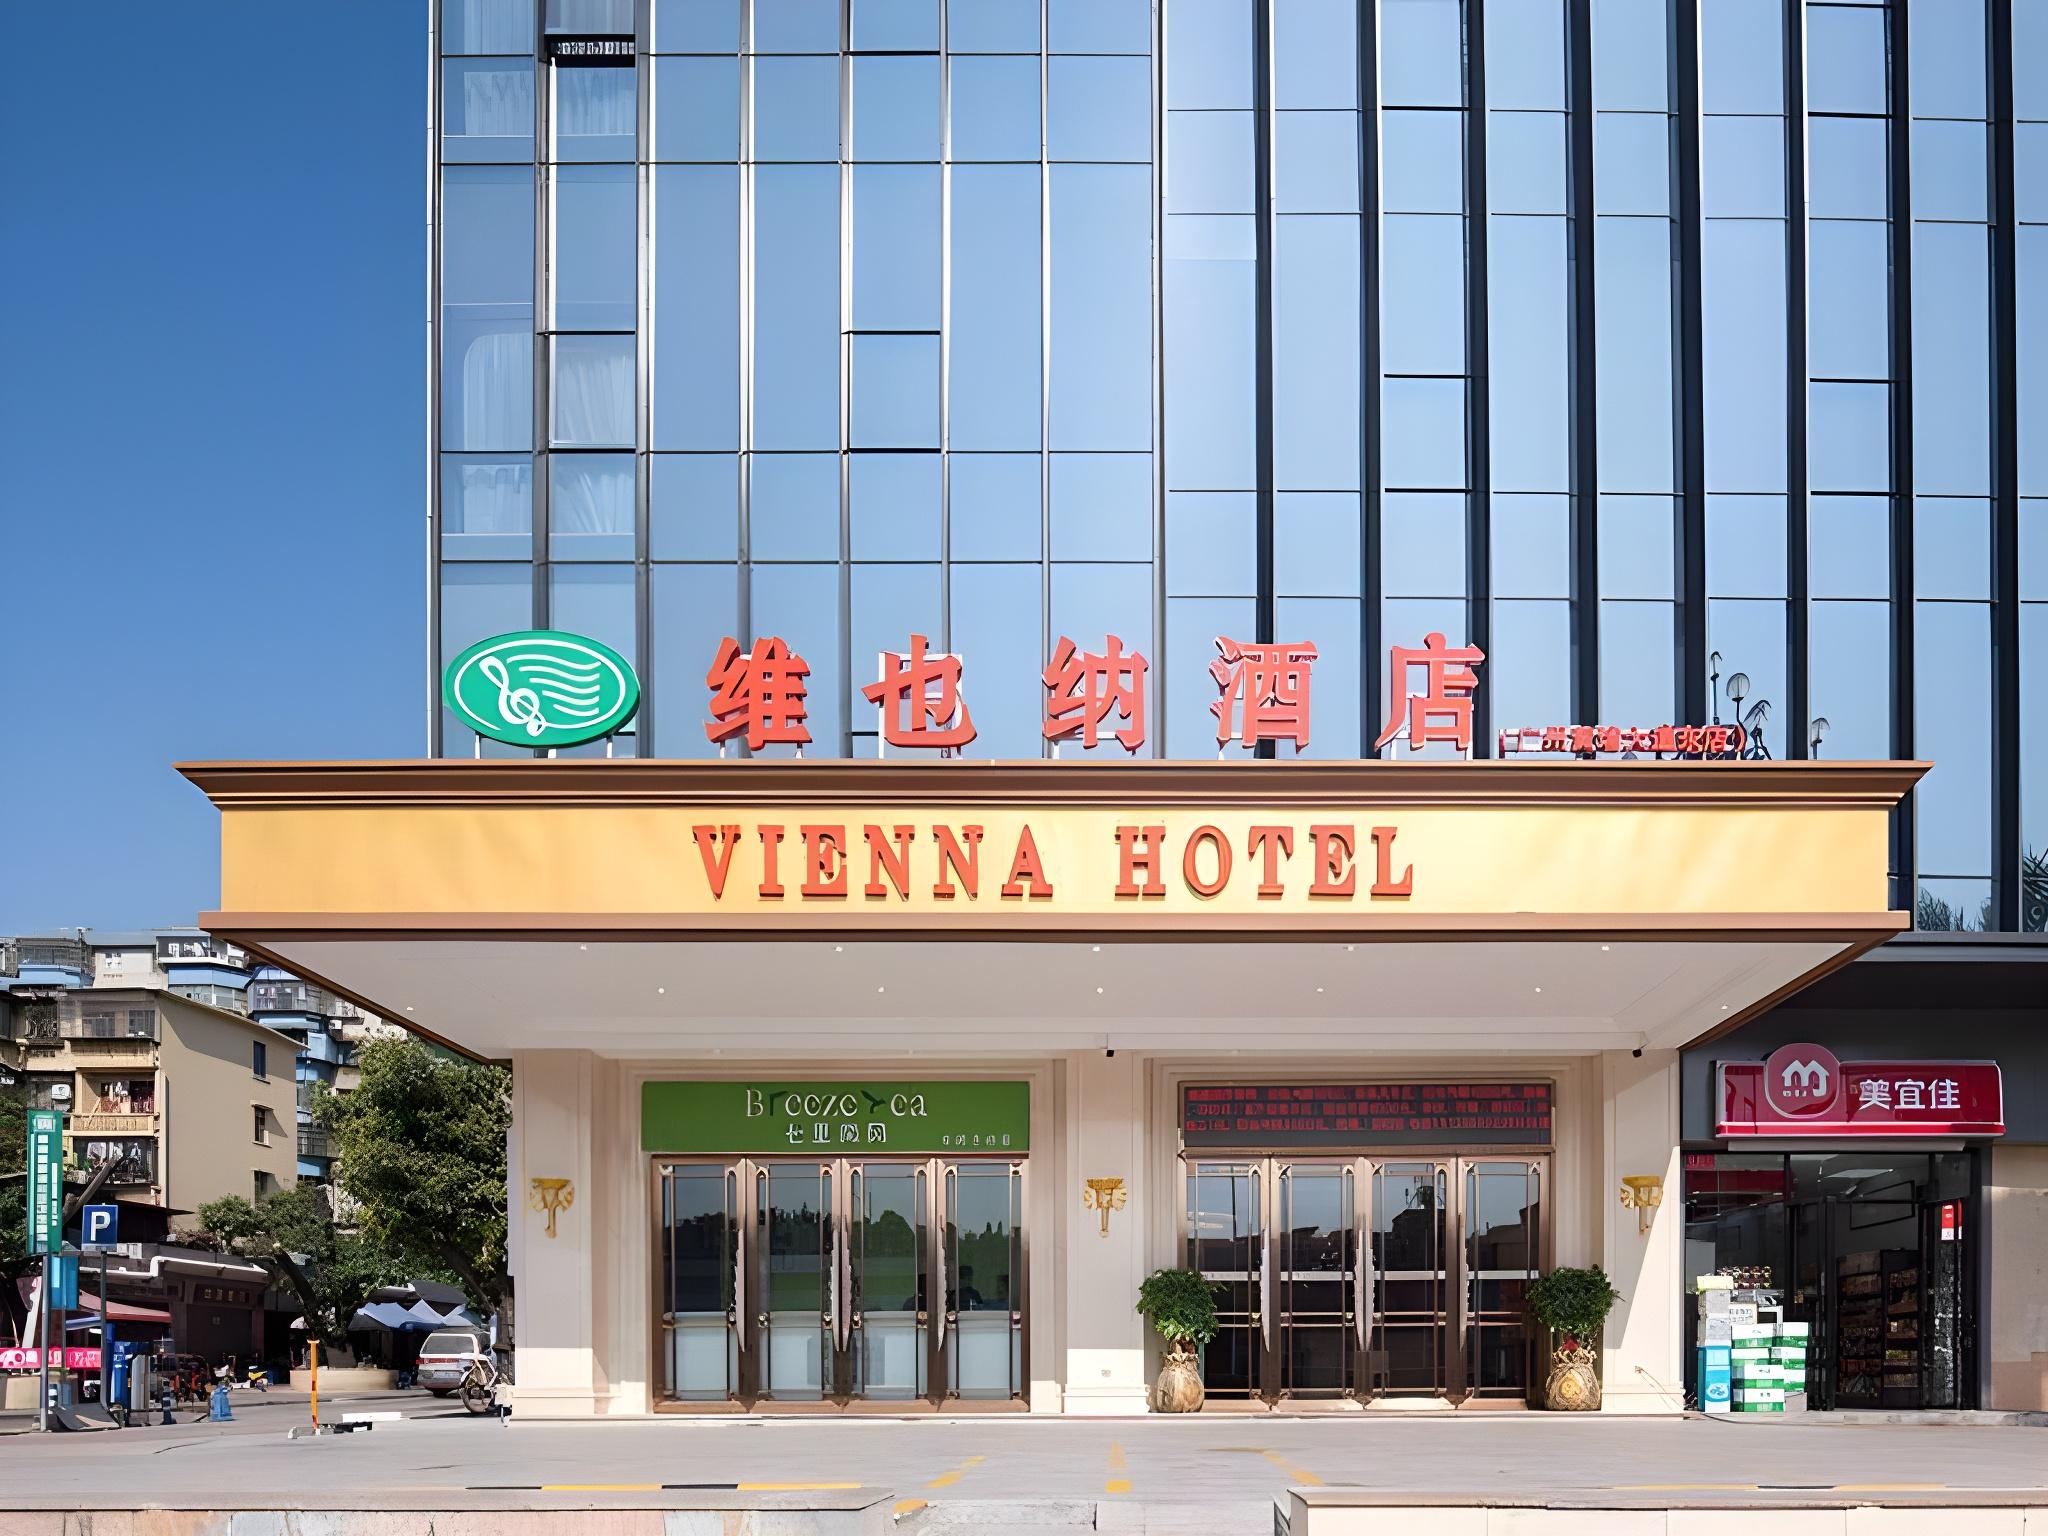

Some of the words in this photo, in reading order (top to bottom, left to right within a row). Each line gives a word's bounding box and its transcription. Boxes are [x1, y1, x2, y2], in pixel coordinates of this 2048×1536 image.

[703, 632, 1487, 751] 维也纳酒店
[692, 824, 1053, 901] VIENNA
[1114, 824, 1413, 900] HOTEL
[1858, 1078, 1961, 1111] 美宜佳
[90, 1211, 111, 1241] P
